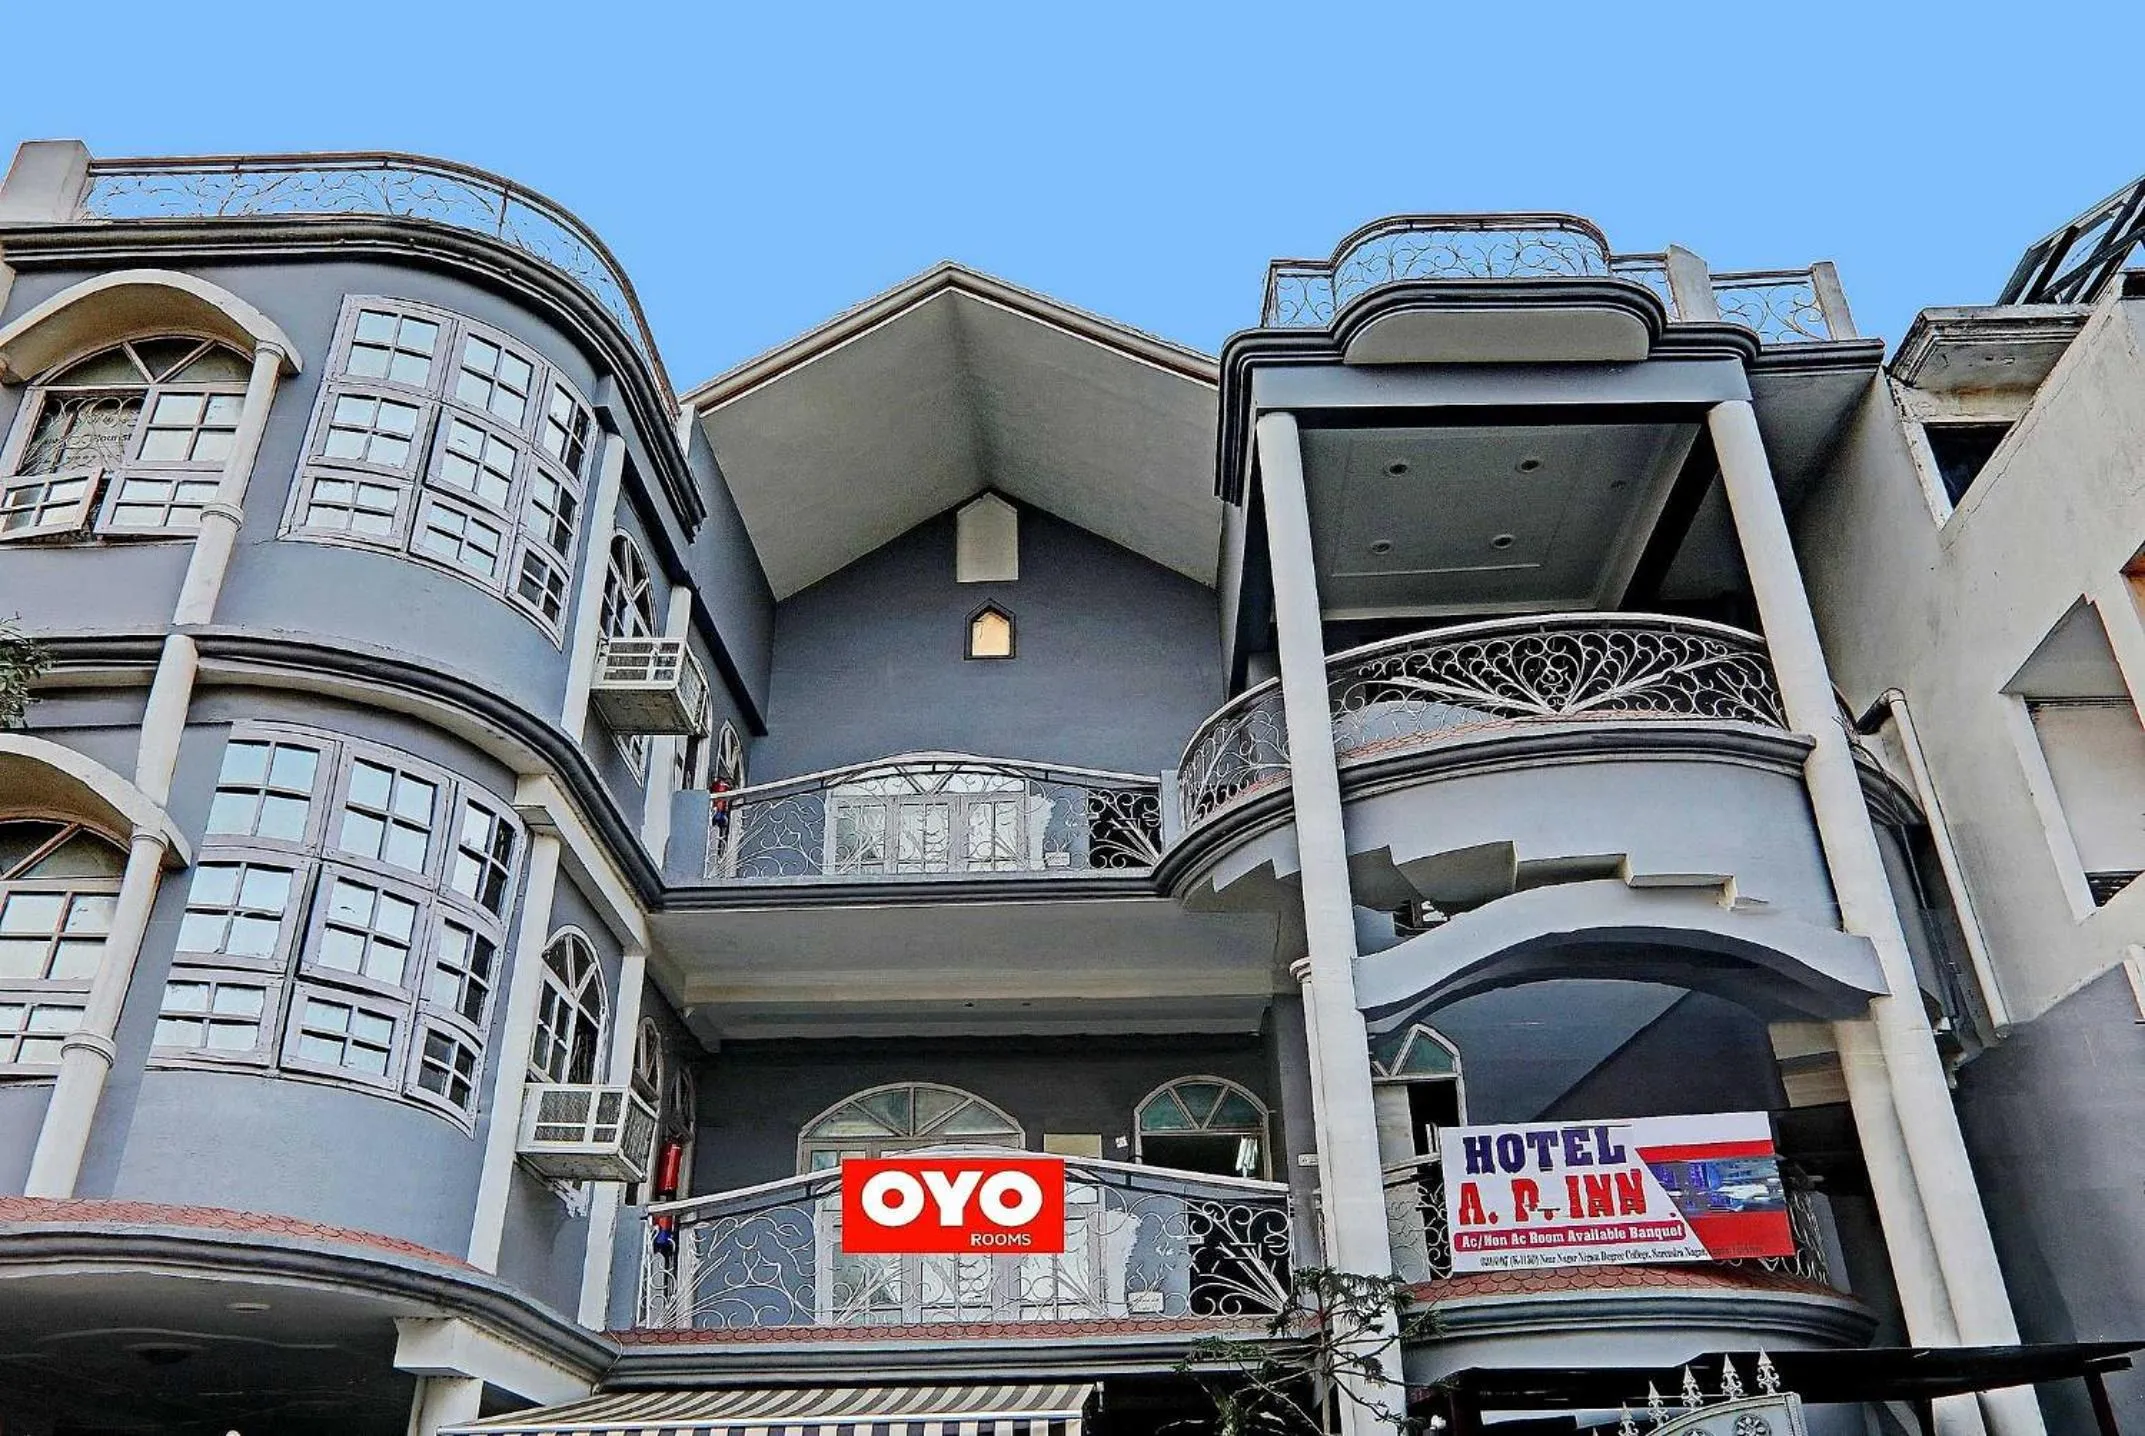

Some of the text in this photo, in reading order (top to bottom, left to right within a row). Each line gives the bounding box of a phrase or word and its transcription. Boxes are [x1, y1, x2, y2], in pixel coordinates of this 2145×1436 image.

[1462, 1126, 1627, 1174] HOTEL
[861, 1170, 1044, 1227] OYO
[1459, 1182, 1498, 1225] A.
[1565, 1169, 1647, 1219] INN
[970, 1233, 1032, 1246] ROOMS
[1511, 1233, 1527, 1246] Ac
[1529, 1231, 1565, 1244] Room
[1567, 1226, 1626, 1242] Available
[1629, 1224, 1683, 1240] Banquet
